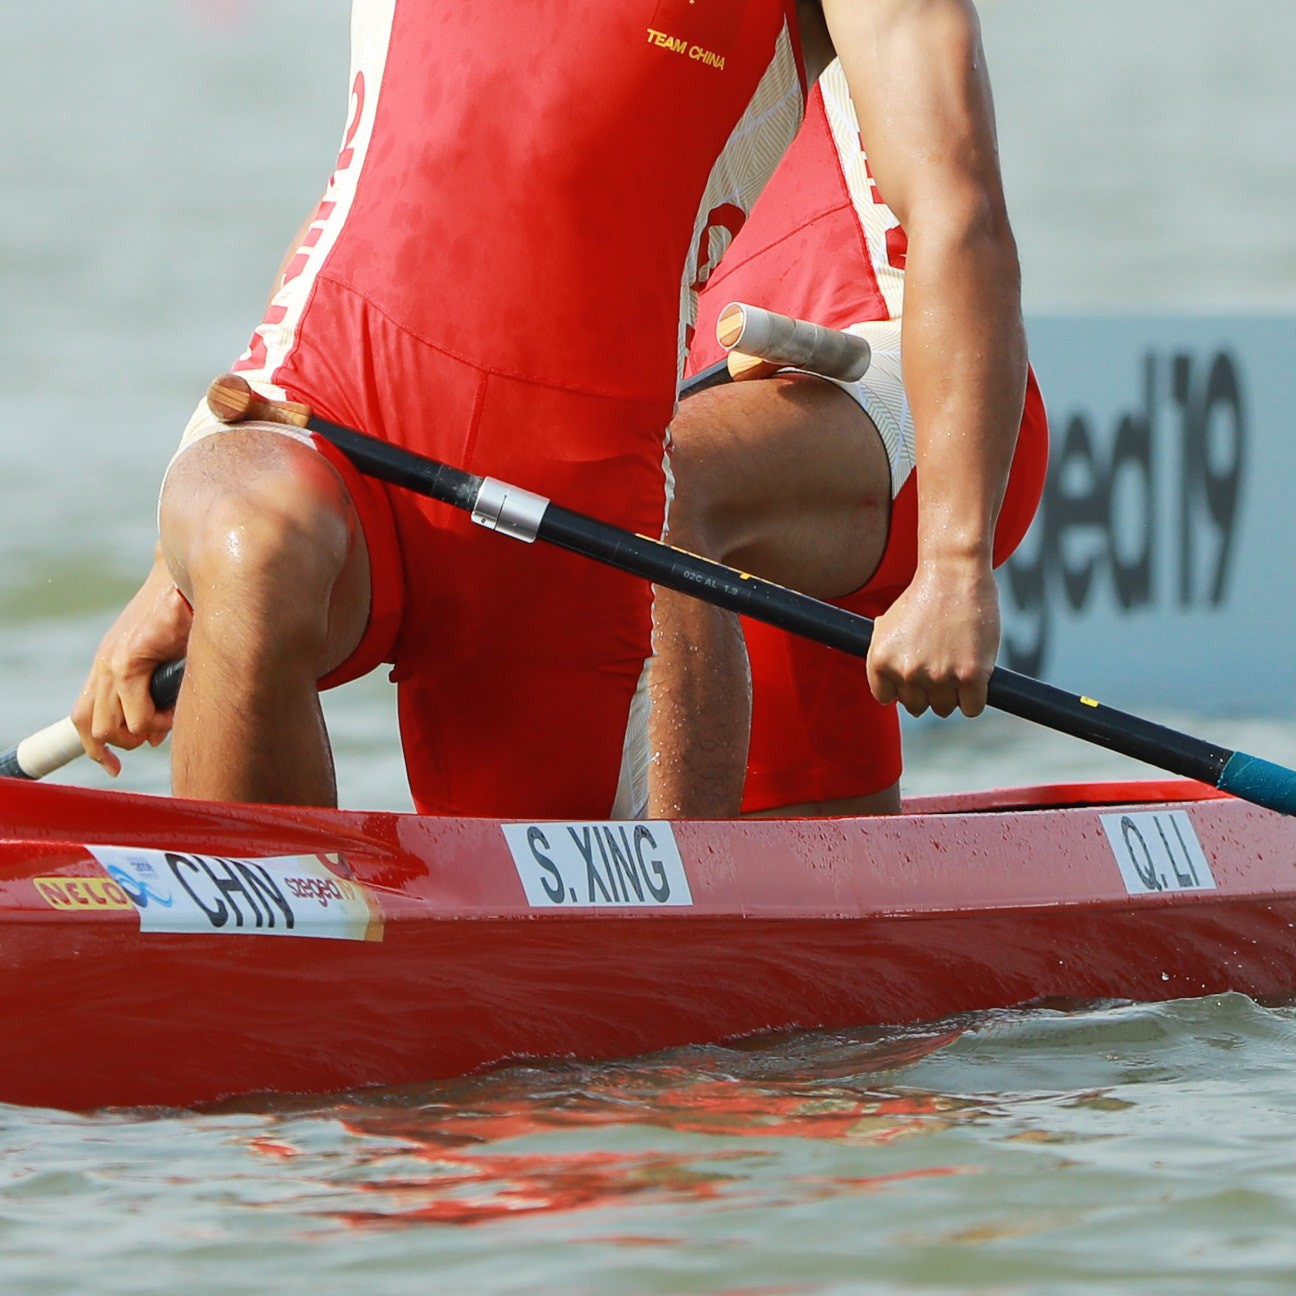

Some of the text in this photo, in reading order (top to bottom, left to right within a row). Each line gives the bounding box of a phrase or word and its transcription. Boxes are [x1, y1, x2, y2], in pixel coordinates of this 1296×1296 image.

[646, 27, 726, 72] TEAM CHINA
[38, 882, 129, 906] NELO
[164, 852, 295, 931] CHN
[527, 824, 671, 904] S. XING
